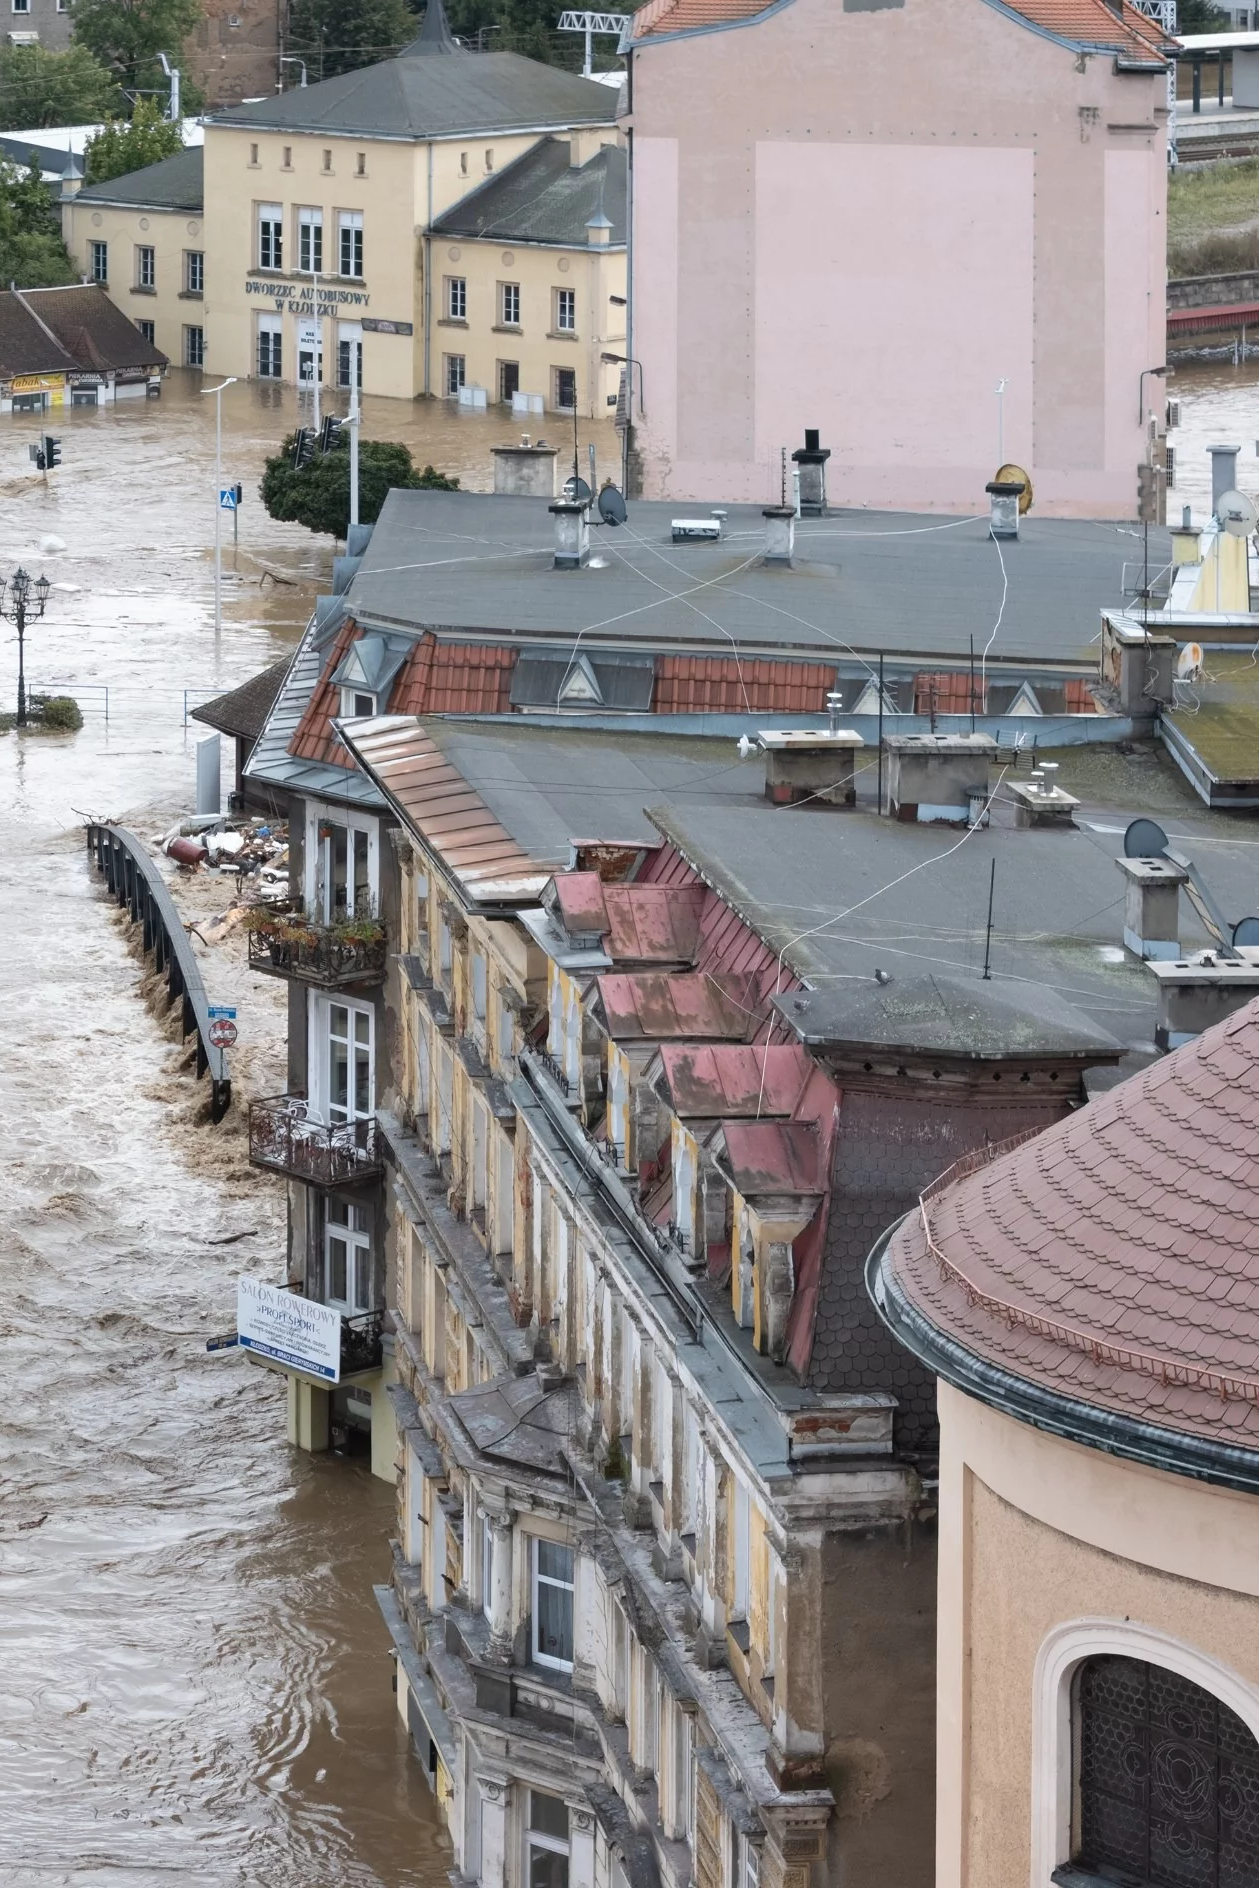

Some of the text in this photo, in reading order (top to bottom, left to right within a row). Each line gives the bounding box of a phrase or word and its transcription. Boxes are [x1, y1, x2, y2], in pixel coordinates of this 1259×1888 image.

[246, 282, 296, 298] DWORZEC
[275, 299, 284, 311] W
[241, 1280, 274, 1304] SALON
[278, 1294, 337, 1326] ROWEROWY
